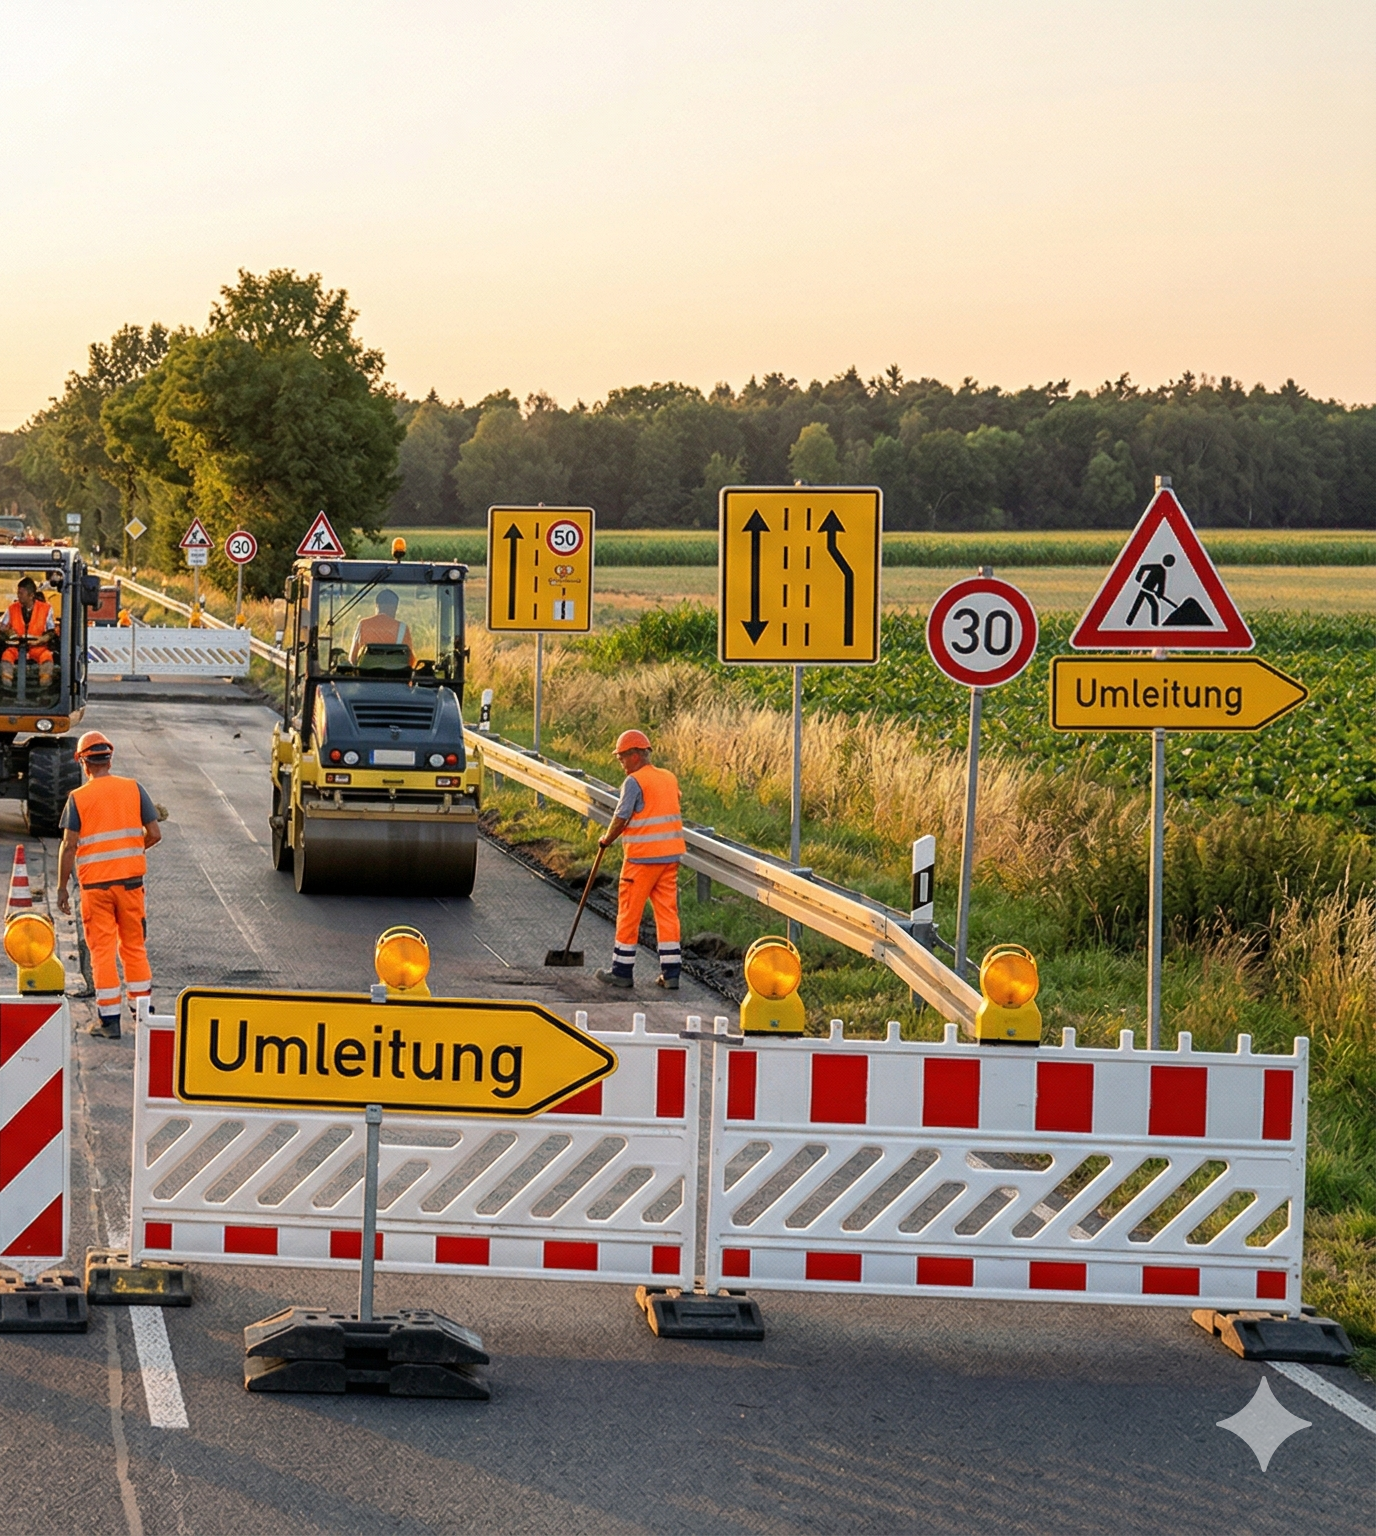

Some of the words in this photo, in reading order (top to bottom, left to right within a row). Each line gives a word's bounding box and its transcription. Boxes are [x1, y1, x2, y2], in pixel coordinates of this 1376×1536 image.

[232, 540, 250, 554] 30
[554, 530, 576, 546] 50
[951, 608, 1013, 656] 30
[1077, 677, 1242, 716] Umleitung
[210, 1018, 523, 1099] Umleitung
